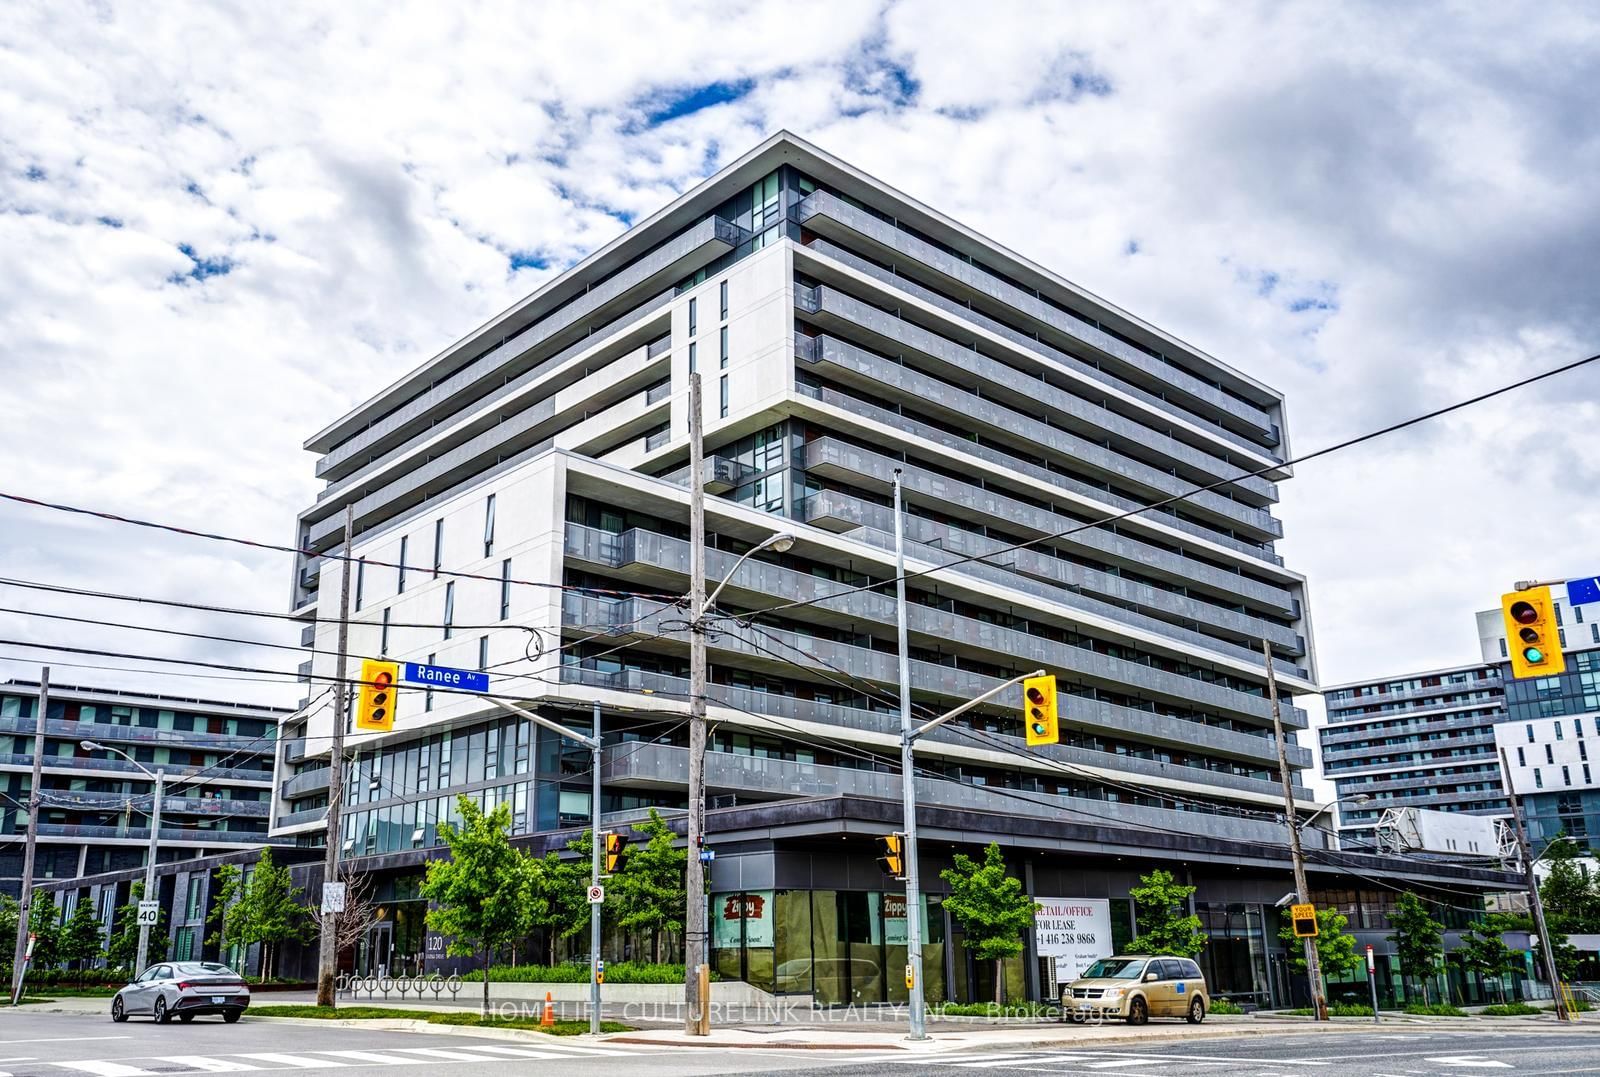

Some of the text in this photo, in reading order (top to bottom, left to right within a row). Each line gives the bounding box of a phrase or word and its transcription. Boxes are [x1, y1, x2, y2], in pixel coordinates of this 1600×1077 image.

[417, 665, 476, 684] Ranee Av
[139, 910, 157, 922] 40
[1035, 919, 1076, 931] FOR LEASE
[428, 936, 443, 950] 120
[1046, 933, 1059, 945] 416
[1061, 933, 1075, 945] 238
[1076, 933, 1096, 945] 9868
